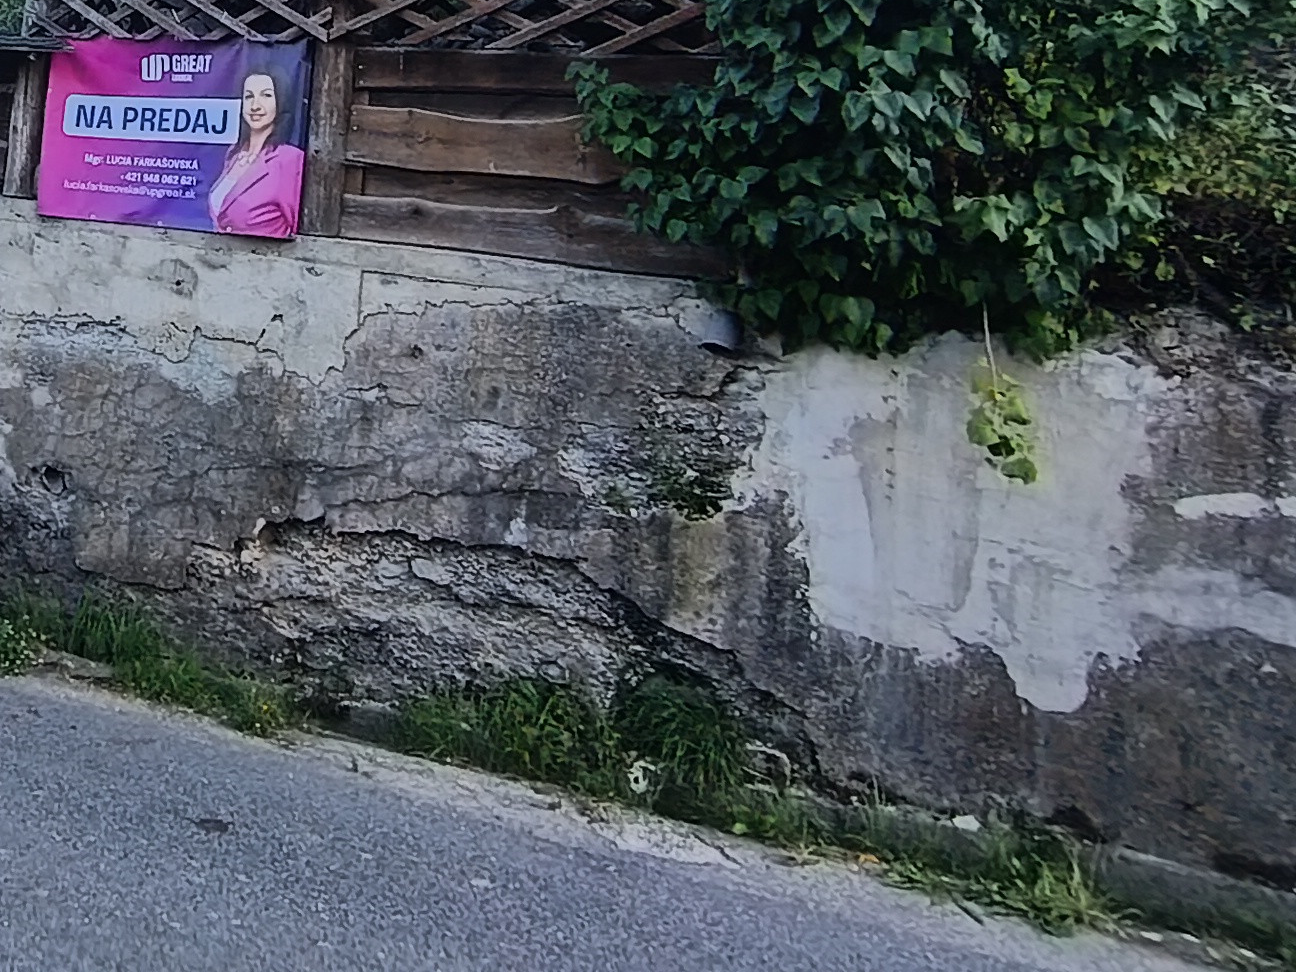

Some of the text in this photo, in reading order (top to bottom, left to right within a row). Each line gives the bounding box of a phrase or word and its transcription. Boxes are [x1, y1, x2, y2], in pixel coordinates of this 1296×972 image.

[172, 54, 212, 73] GREAT
[75, 105, 228, 134] NA PREDAJ
[106, 155, 132, 166] LUCIA
